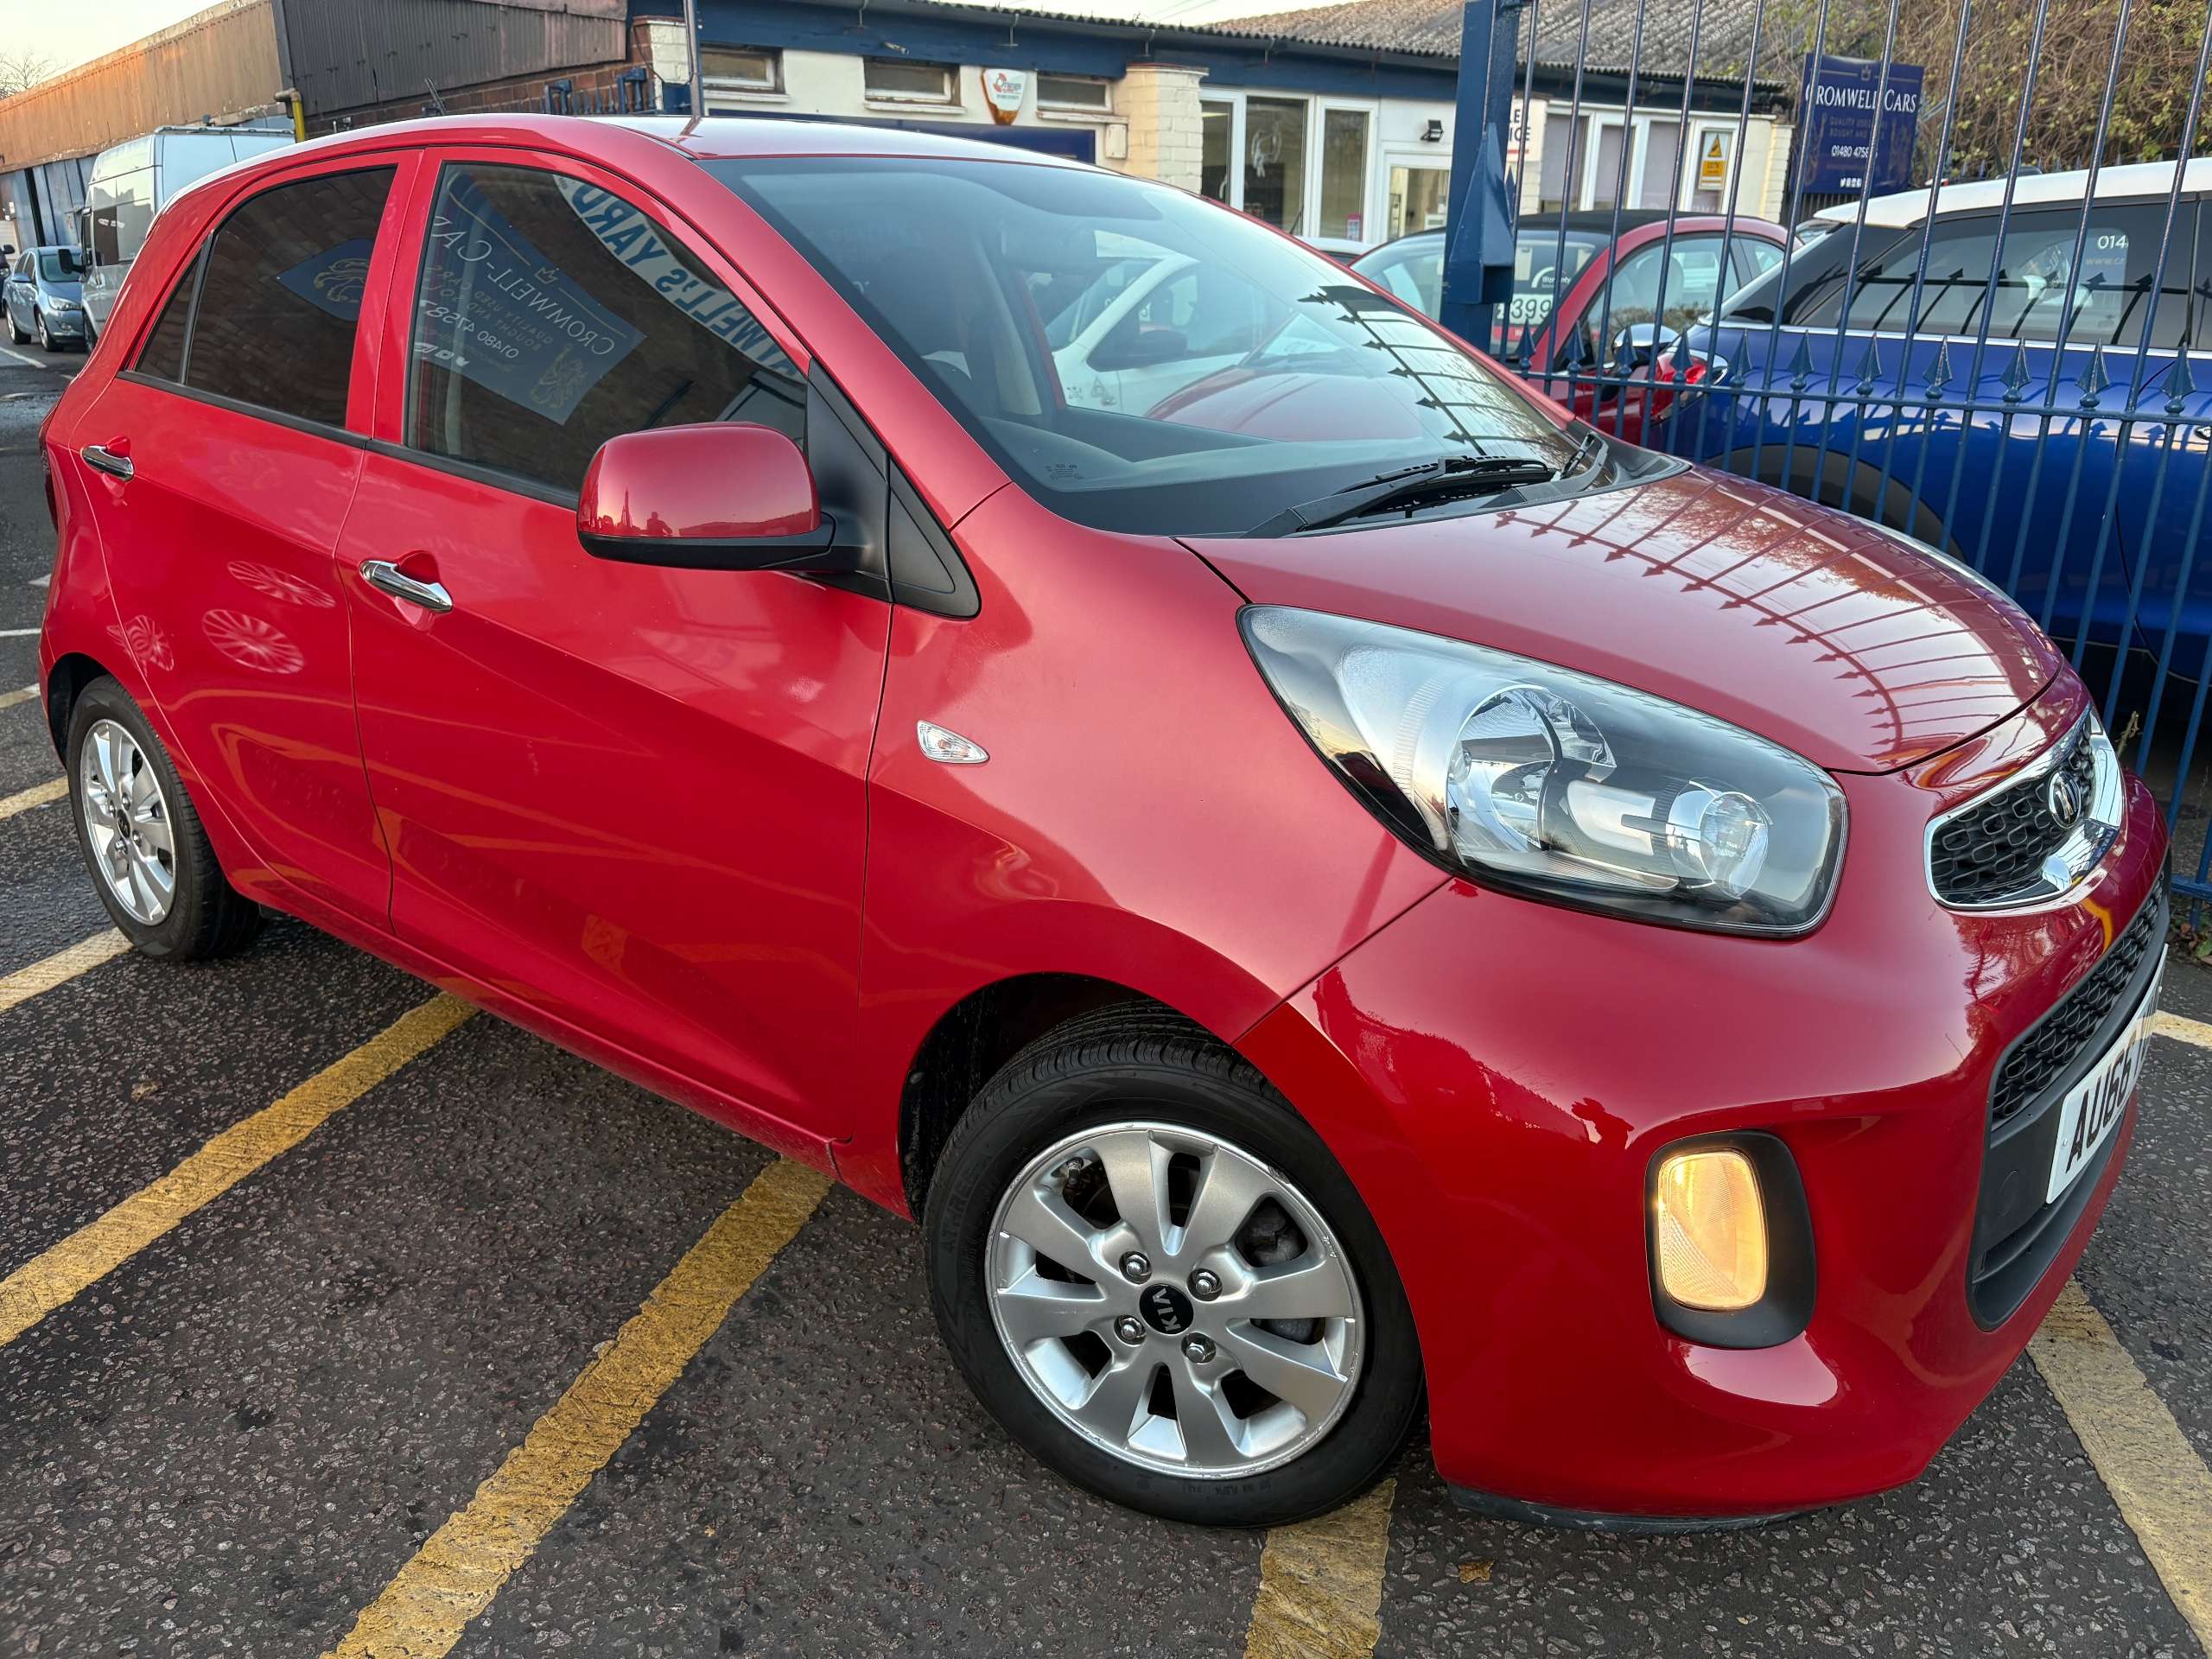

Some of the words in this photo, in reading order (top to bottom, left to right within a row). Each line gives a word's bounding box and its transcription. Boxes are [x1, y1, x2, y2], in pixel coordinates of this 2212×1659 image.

[1884, 88, 1917, 113] CARS
[1831, 144, 1853, 158] 01480
[2098, 234, 2129, 249] 014
[2065, 1029, 2137, 1173] AU66
[1152, 1287, 1181, 1331] KIA
